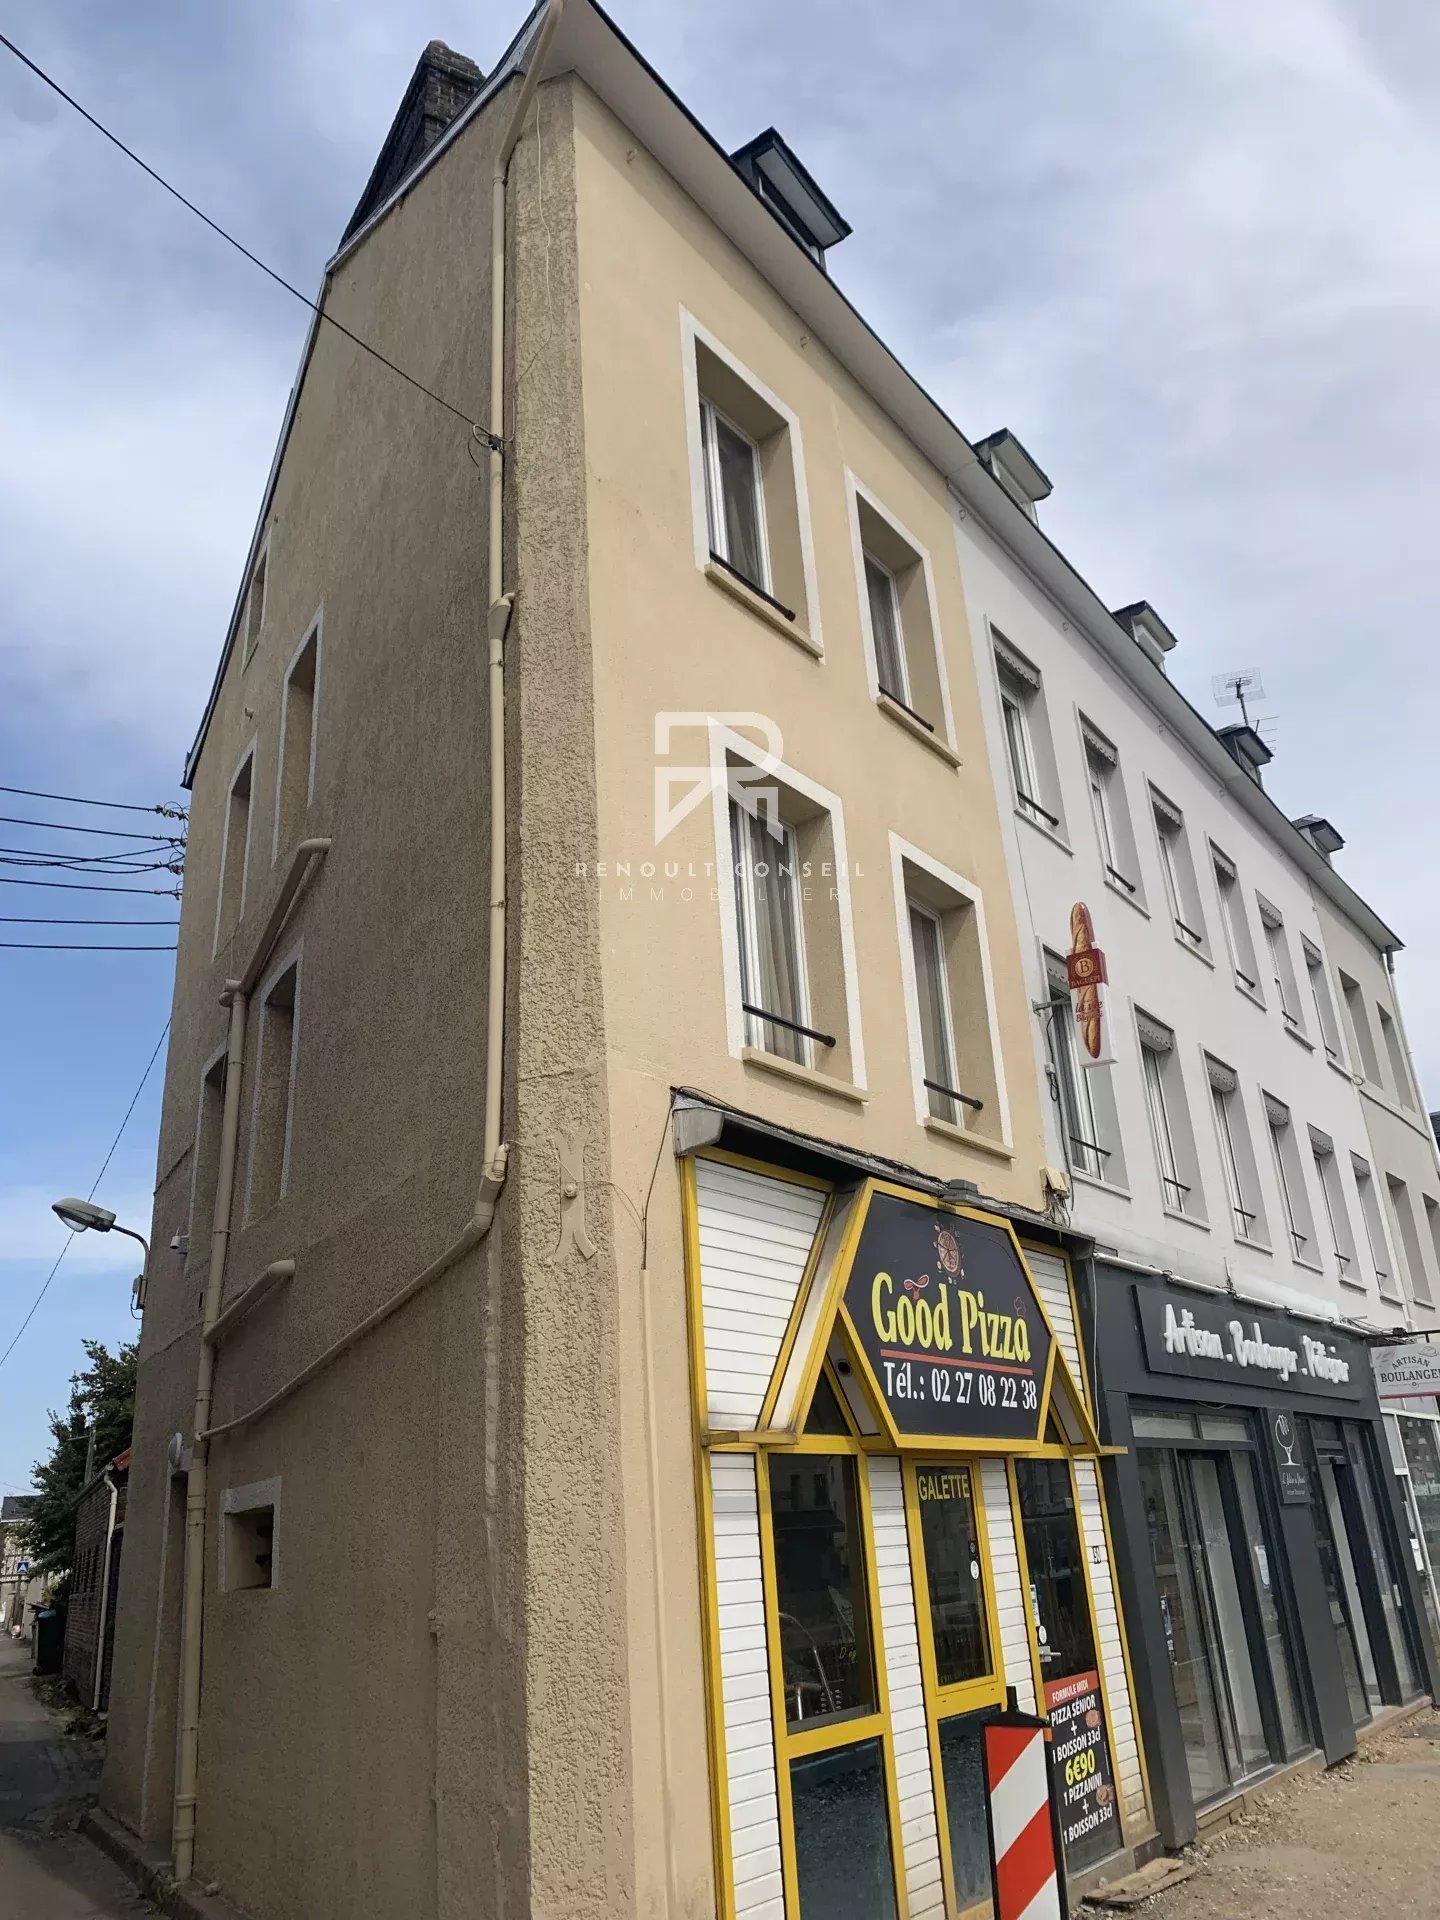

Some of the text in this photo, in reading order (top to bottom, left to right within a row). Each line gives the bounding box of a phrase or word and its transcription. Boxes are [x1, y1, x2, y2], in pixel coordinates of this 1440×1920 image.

[1080, 960, 1089, 973] B
[872, 1272, 1031, 1363] Good Pizza
[1391, 1356, 1431, 1370] ARTISAN
[883, 1361, 1038, 1410] Tél.: 02 27 08 22 38
[918, 1474, 970, 1501] GALETTE
[1051, 1694, 1096, 1727] PIZZA SÉNIOR
[1052, 1683, 1077, 1704] FORMULE
[1057, 1733, 1087, 1762] BOISSON
[1087, 1726, 1101, 1746] 33cl
[1065, 1748, 1095, 1786] 6€90
[1063, 1771, 1102, 1807] 1 PIZZANINI
[1063, 1802, 1113, 1845] 1 BOISSON 33cl
